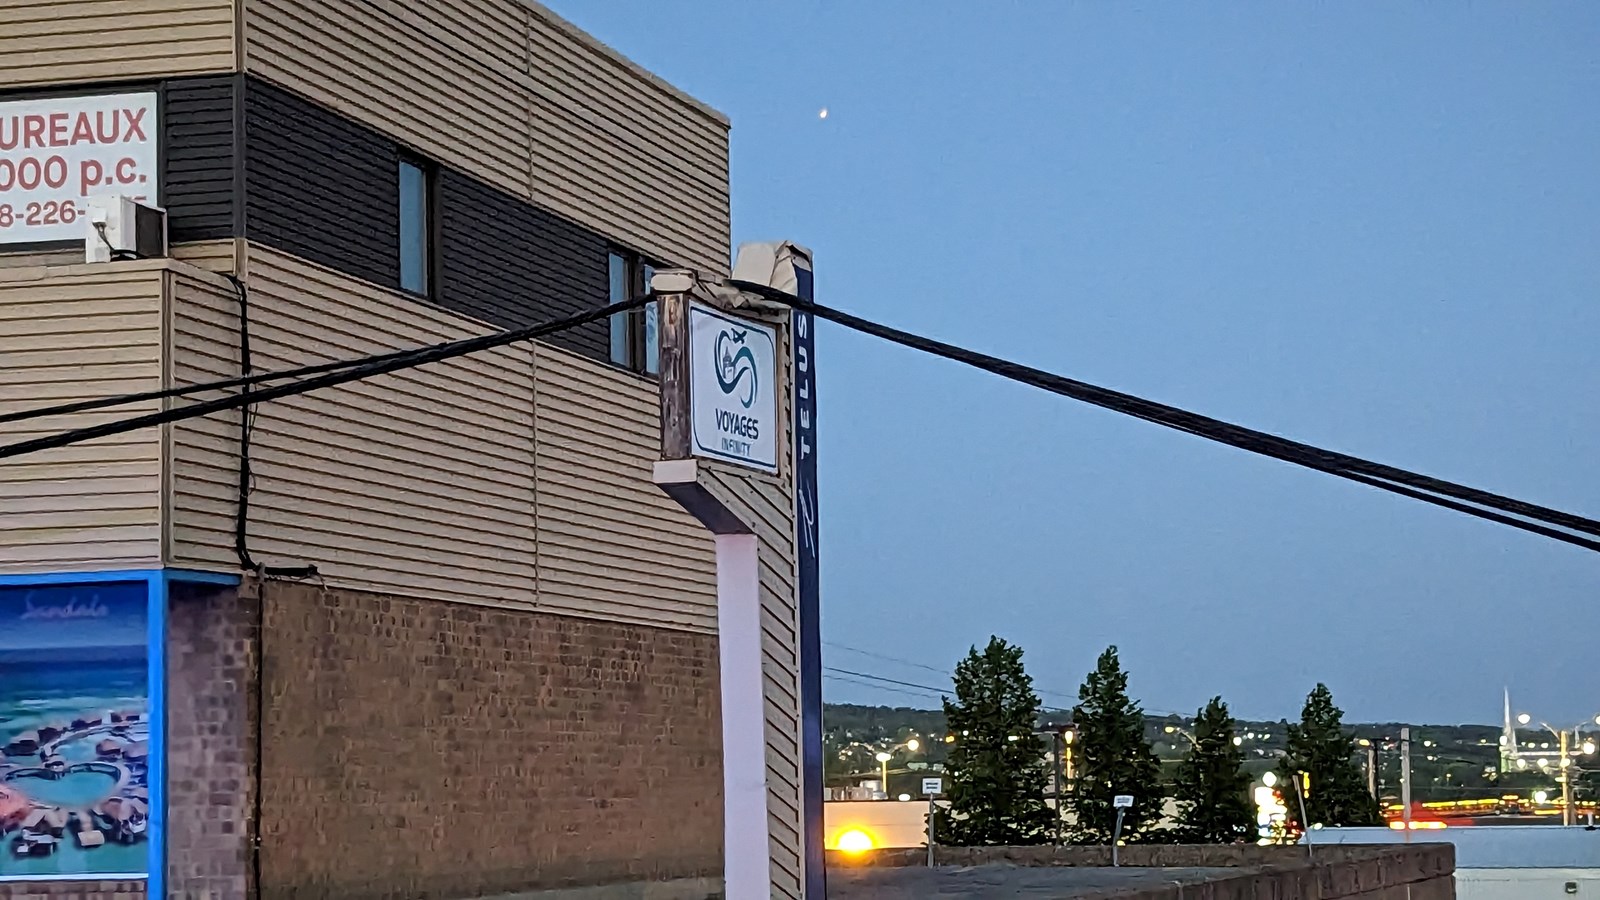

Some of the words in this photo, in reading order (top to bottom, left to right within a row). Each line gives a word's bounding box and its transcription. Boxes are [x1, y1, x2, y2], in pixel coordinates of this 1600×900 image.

[80, 158, 147, 196] p.c.
[0, 196, 147, 228] 8-226-
[798, 313, 811, 460] TELUS
[715, 408, 759, 440] VOYAGES
